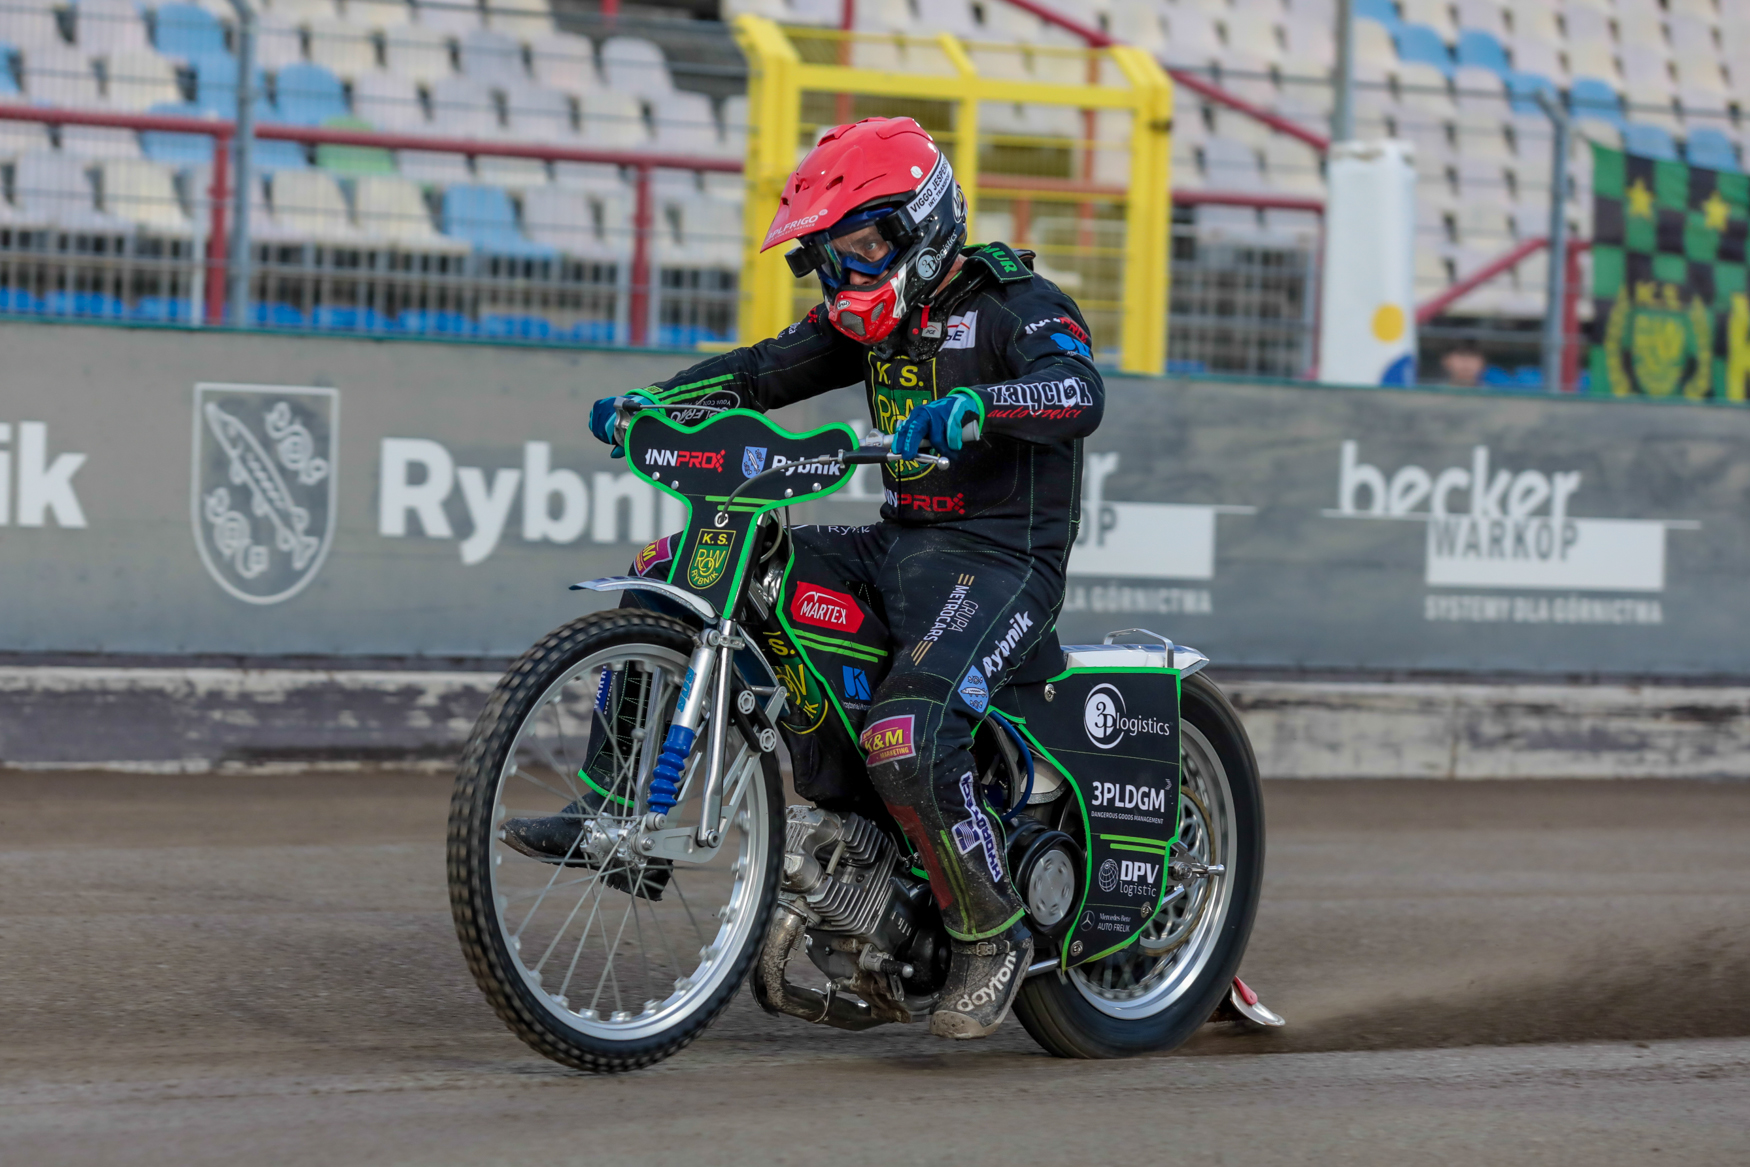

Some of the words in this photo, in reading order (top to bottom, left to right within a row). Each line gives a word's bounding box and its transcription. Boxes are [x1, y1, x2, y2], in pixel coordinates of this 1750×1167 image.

[910, 188, 933, 213] VIGGO
[1338, 439, 1582, 522] becker
[379, 437, 686, 567] Rybn
[1434, 518, 1579, 561] WARKOP
[691, 569, 719, 585] RYBNIK
[799, 600, 848, 626] MARTEX
[922, 584, 970, 642] METROCARS
[947, 599, 979, 633] GRUPA
[864, 729, 904, 753] K&M
[1091, 780, 1165, 813] 3PLDGM
[1091, 810, 1118, 819] DANGEROUS
[1118, 813, 1134, 821] GOODS
[1120, 860, 1160, 885] DPV
[1119, 879, 1157, 898] logistic
[1097, 922, 1113, 931] AUTO
